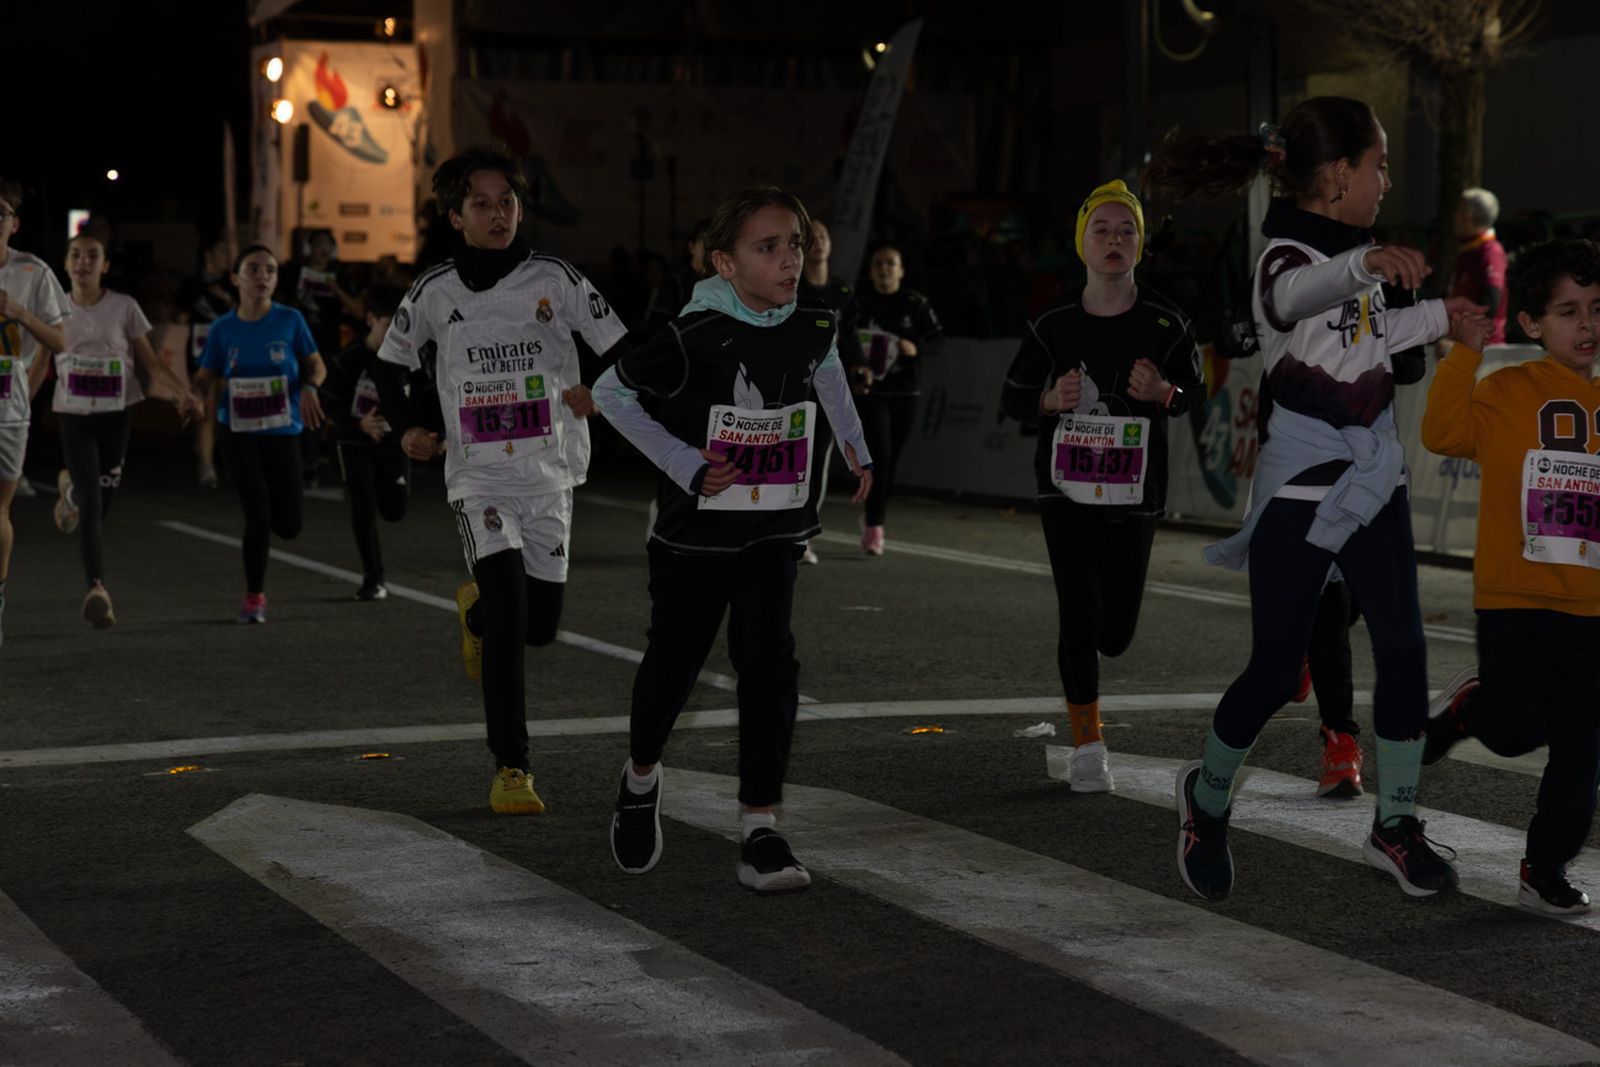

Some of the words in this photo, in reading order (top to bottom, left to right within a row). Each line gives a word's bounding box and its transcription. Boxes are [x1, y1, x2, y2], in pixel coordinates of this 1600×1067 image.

[467, 340, 542, 363] Emirates
[482, 361, 497, 374] FLY
[500, 358, 534, 373] BETTER
[475, 384, 505, 393] NOCHE
[506, 382, 517, 391] DE
[465, 394, 485, 405] SAN
[735, 420, 770, 431] NOCHE
[770, 420, 783, 430] DE
[1075, 424, 1103, 435] NOCHE
[1104, 426, 1116, 435] DE
[1538, 399, 1600, 454] 8
[719, 429, 744, 442] SAN
[744, 430, 782, 444] ANTÓN
[1063, 434, 1081, 444] SAN
[1553, 464, 1588, 477] NOCHE
[1537, 477, 1563, 489] SAN
